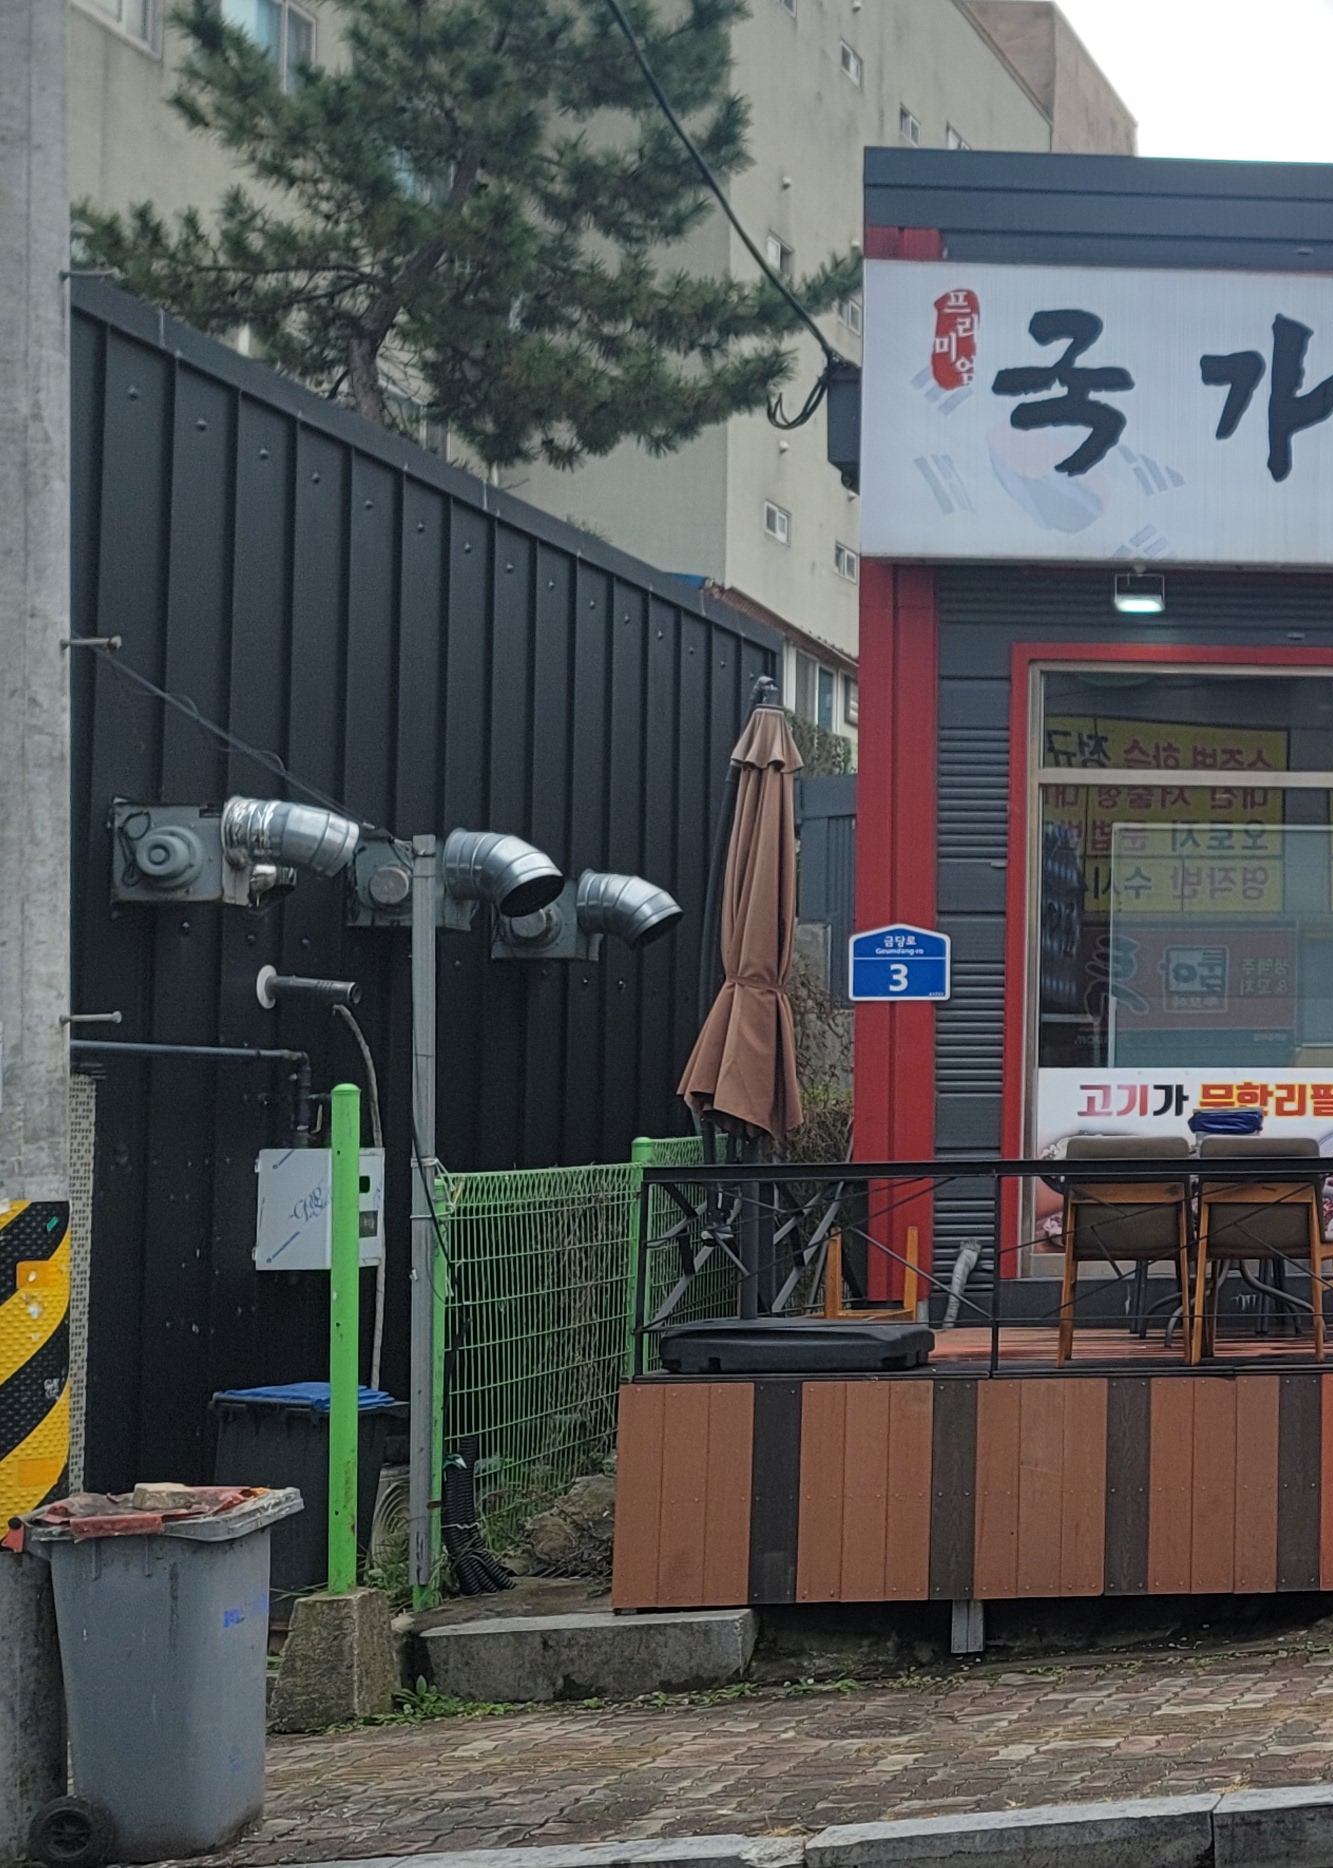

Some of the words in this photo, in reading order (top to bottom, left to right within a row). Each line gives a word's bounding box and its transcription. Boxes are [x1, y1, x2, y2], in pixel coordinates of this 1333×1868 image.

[875, 948, 924, 956] Geumdang-ro
[884, 936, 917, 948] 금당로
[889, 964, 908, 992] 3
[1077, 1083, 1190, 1117] 고기가
